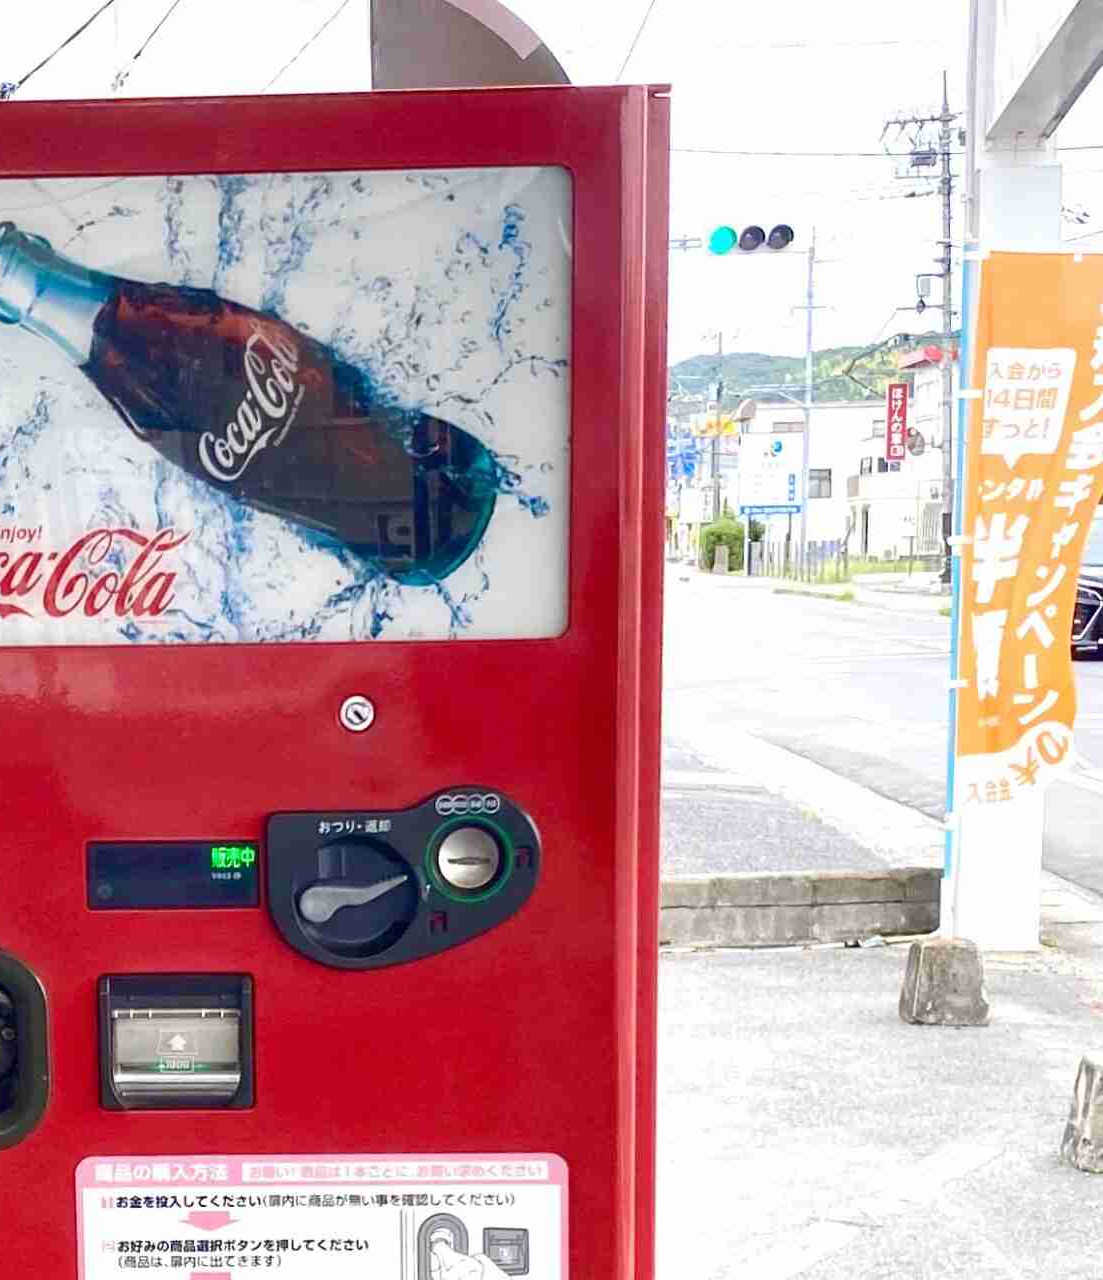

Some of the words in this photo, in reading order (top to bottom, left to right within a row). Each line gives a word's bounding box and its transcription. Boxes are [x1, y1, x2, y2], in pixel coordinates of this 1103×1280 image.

[977, 476, 1045, 502] ンタル
[211, 846, 255, 868] 販売中
[117, 1238, 369, 1253] お好みの商品選択ボタンを押してください
